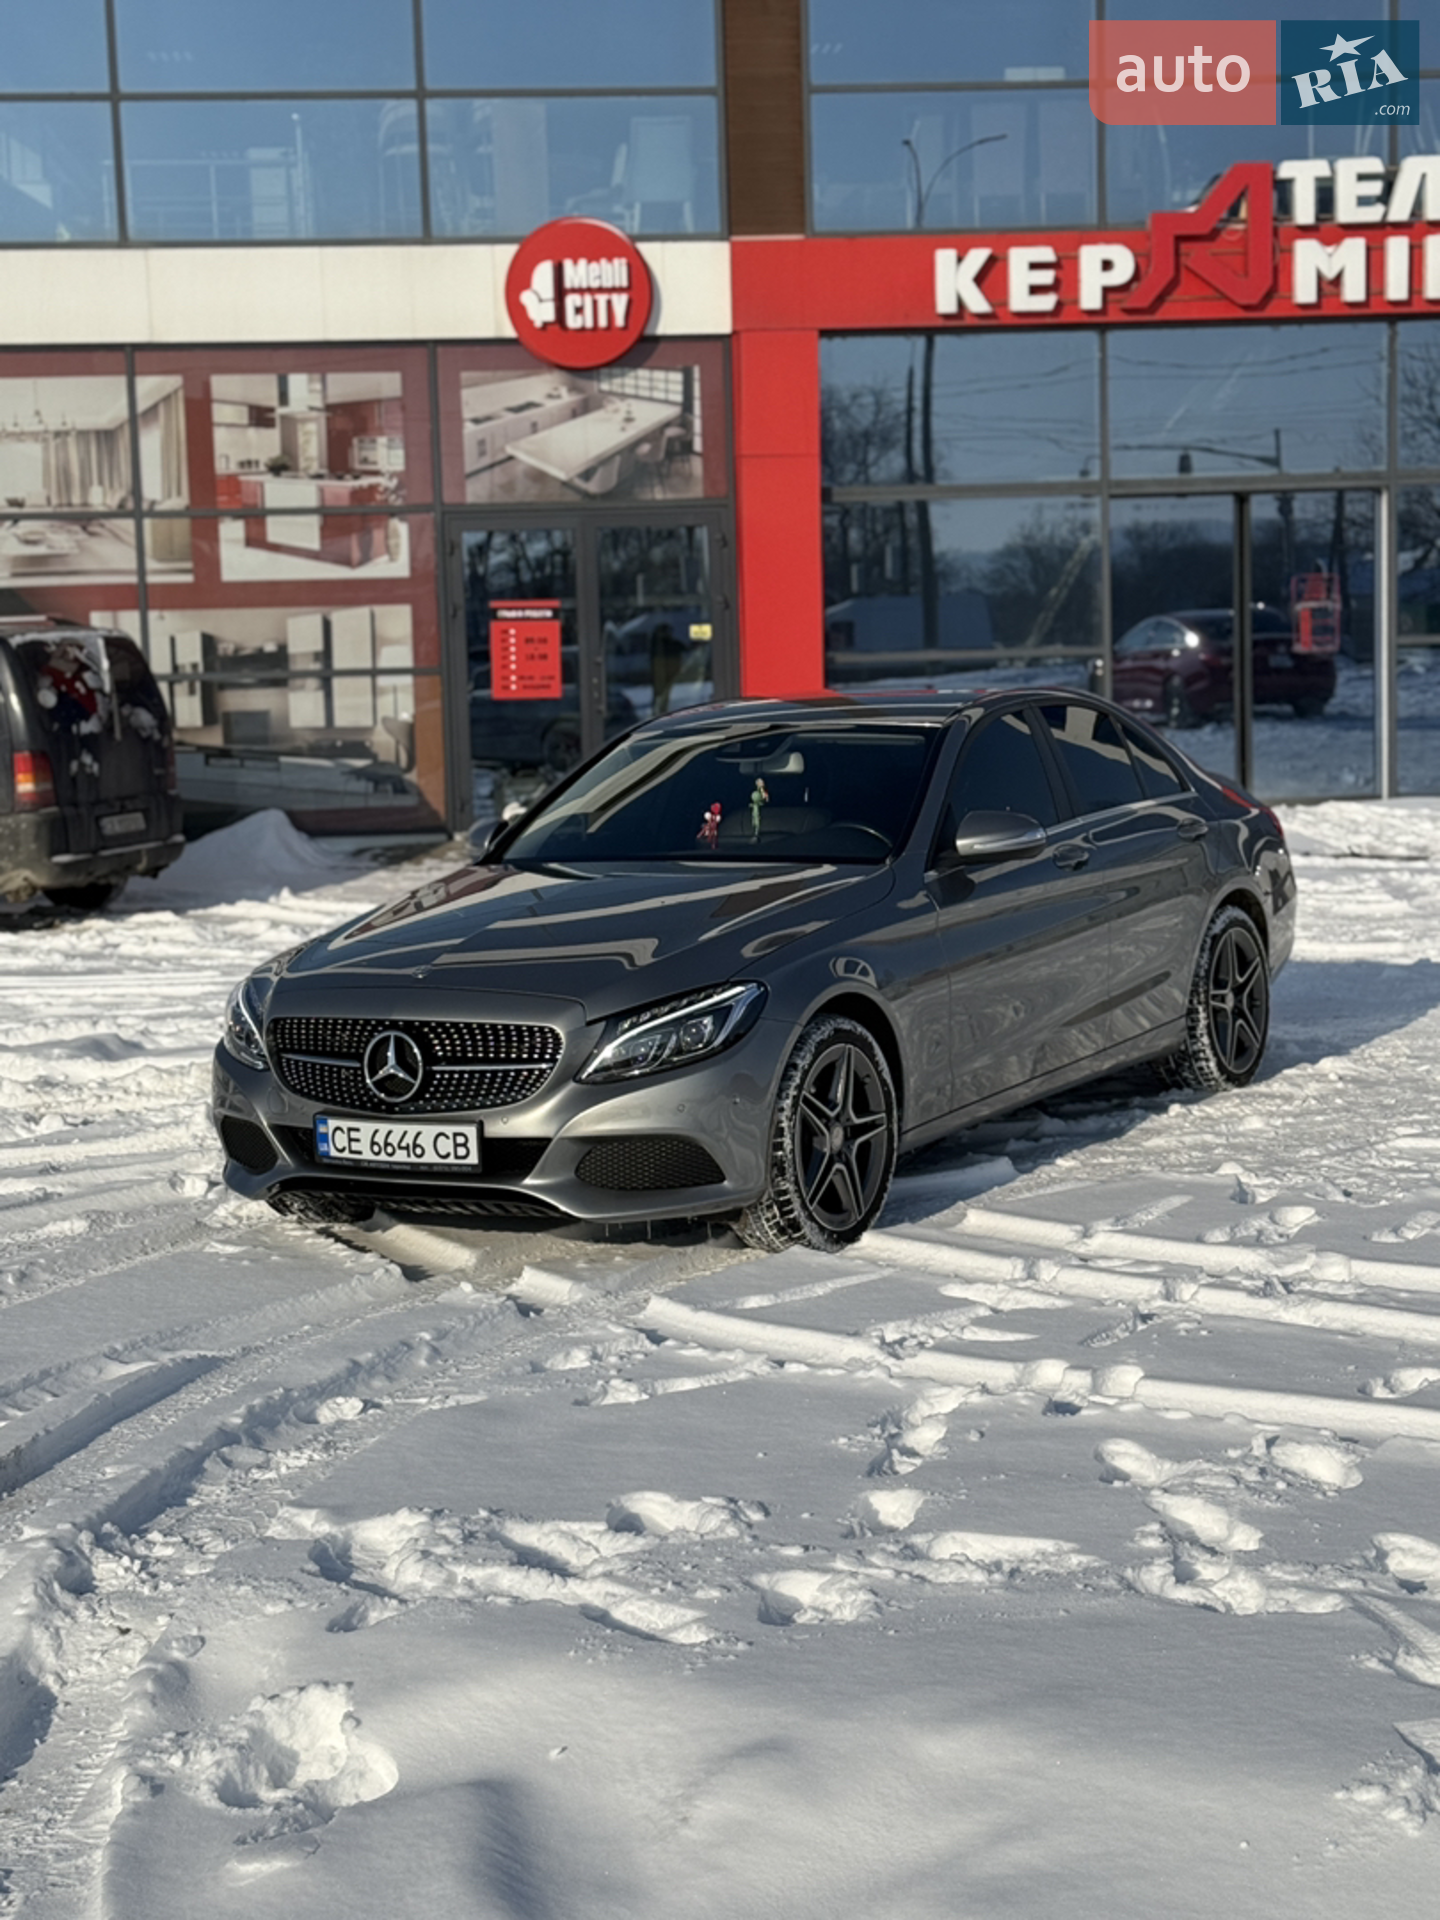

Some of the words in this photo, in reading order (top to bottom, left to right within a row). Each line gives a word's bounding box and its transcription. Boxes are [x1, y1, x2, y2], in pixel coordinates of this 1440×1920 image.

[563, 257, 629, 289] Mebli
[564, 293, 629, 329] CITY
[331, 1126, 363, 1155] CE
[369, 1129, 426, 1159] 6646
[433, 1132, 471, 1160] CB
